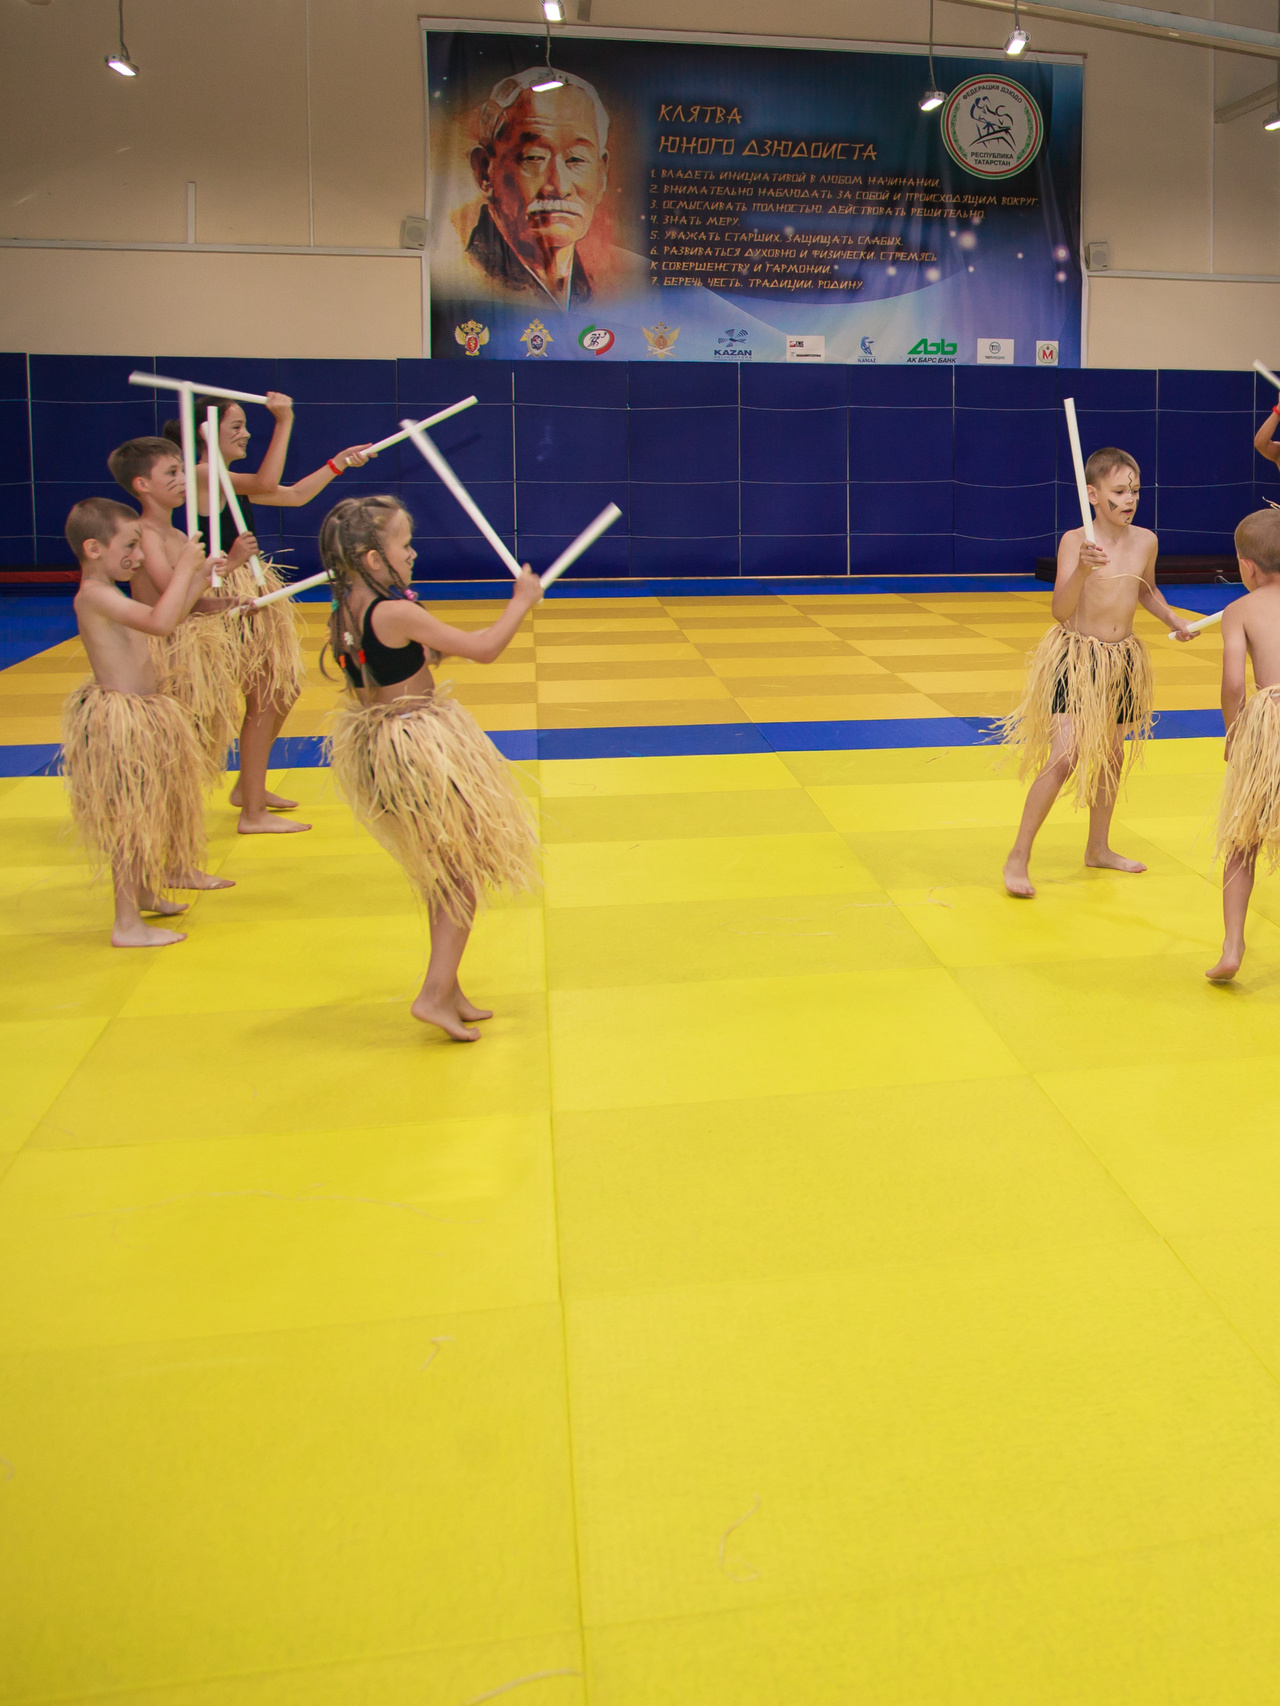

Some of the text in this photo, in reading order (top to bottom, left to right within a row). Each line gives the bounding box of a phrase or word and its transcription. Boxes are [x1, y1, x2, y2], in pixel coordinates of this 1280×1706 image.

[962, 84, 1023, 104] ФЕДЕРАЦИЯ ДЗЮДО
[658, 104, 742, 124] КЛЯТВА
[659, 136, 877, 161] ЮНОГО ДЗЮДОИСТА
[971, 151, 1014, 160] РЕСПУБЛИКА
[661, 169, 716, 180] ВЛАДЕТЬ
[719, 171, 806, 184] ИНИЦИАТИВОЙ
[810, 174, 816, 183] В
[820, 175, 863, 185] ЛЮБОМ
[868, 176, 941, 188] НАЧИНАНИИ.
[649, 184, 659, 194] 2.
[663, 184, 754, 196] ВНИМАТЕЛЬНО
[758, 187, 833, 199] НАБЛЮДАТЬ
[837, 190, 852, 200] ЗА
[856, 190, 890, 201] СОБОЙ
[893, 192, 902, 201] И
[905, 192, 997, 207] ПРОИСХОДЯЩИМ
[650, 199, 658, 209] 3.
[662, 200, 748, 211] ОСМЫСЛИВАТЬ
[828, 204, 907, 216] ДЕЙСТВОВАТЬ
[650, 215, 740, 227] 4. ЗНАТЬ МЕРУ.
[650, 230, 660, 240] 5.
[664, 230, 721, 241] УВАЖАТЬ
[786, 234, 854, 247] ЗАЩИЩАТЬ
[650, 245, 659, 255] 6.
[663, 245, 741, 257] РАЗВИВАТЬСЯ
[744, 247, 796, 258] ДУХОВНО
[800, 249, 808, 258] И
[880, 251, 938, 262] СТРЕМЯСЬ
[649, 261, 832, 275] К СОВЕРШЕНСТВУ И ГАРМОНИИ.
[651, 276, 659, 286] 7.
[663, 276, 703, 287] БЕРЕЧЬ
